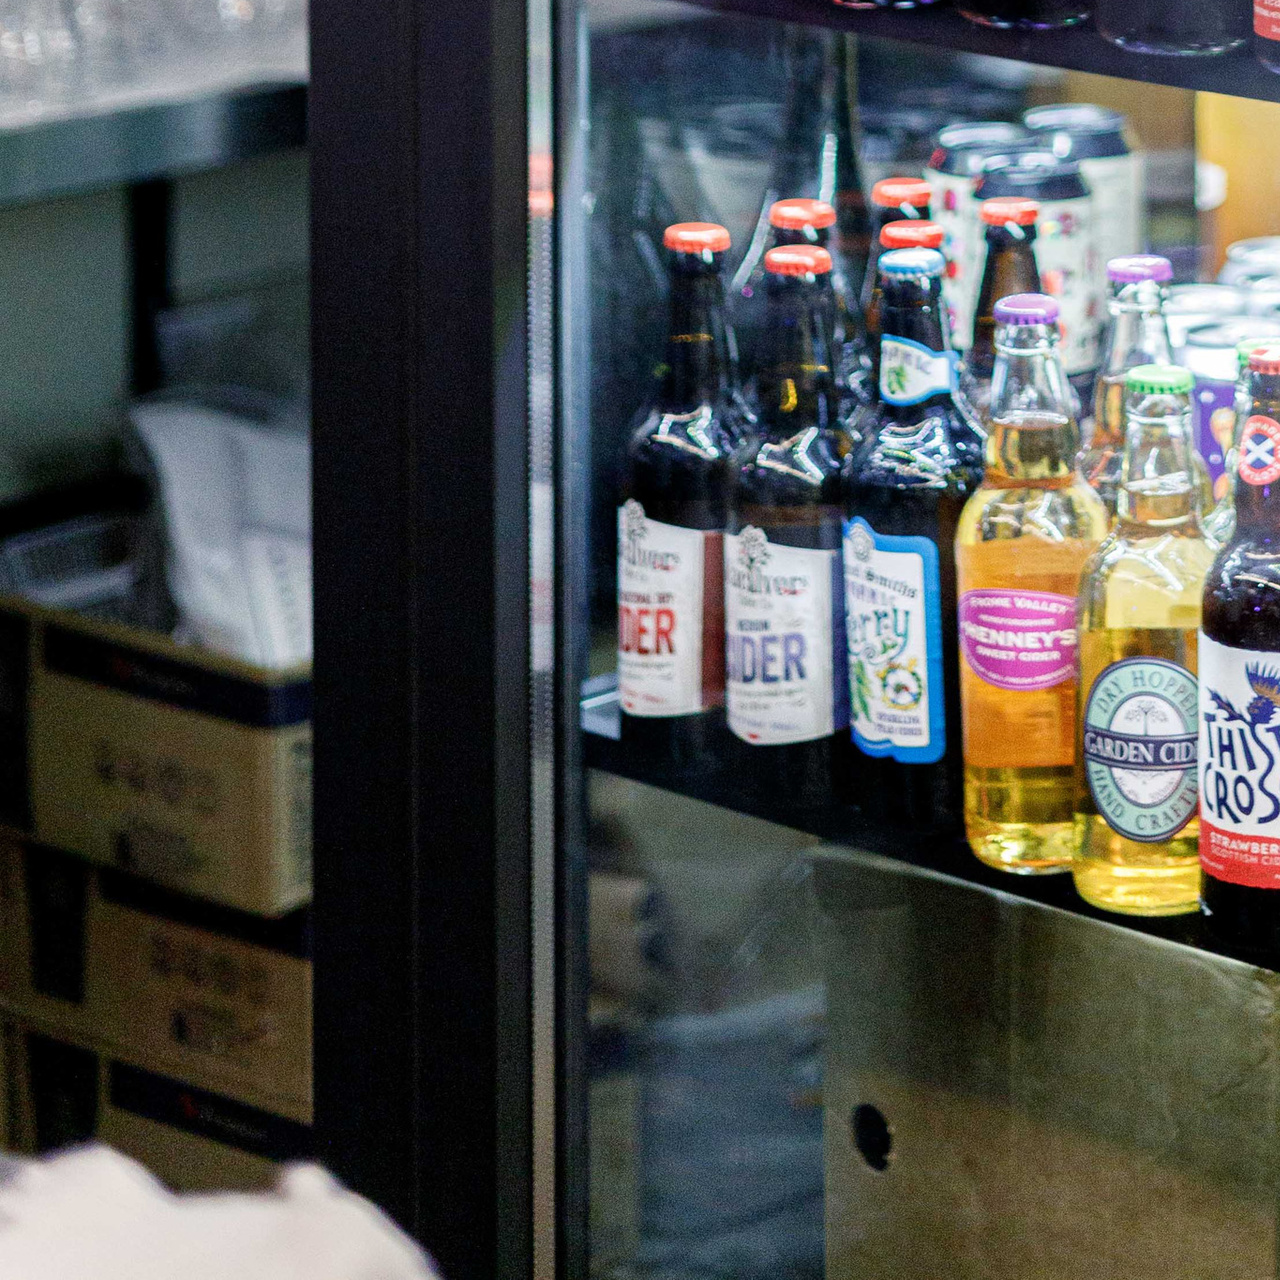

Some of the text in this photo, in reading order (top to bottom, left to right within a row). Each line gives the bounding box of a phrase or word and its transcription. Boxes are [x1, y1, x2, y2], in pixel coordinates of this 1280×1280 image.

[1013, 596, 1069, 613] VALLEY
[1017, 649, 1062, 662] CIDER
[1094, 676, 1125, 715] DRY
[1084, 732, 1155, 763] GARDEN
